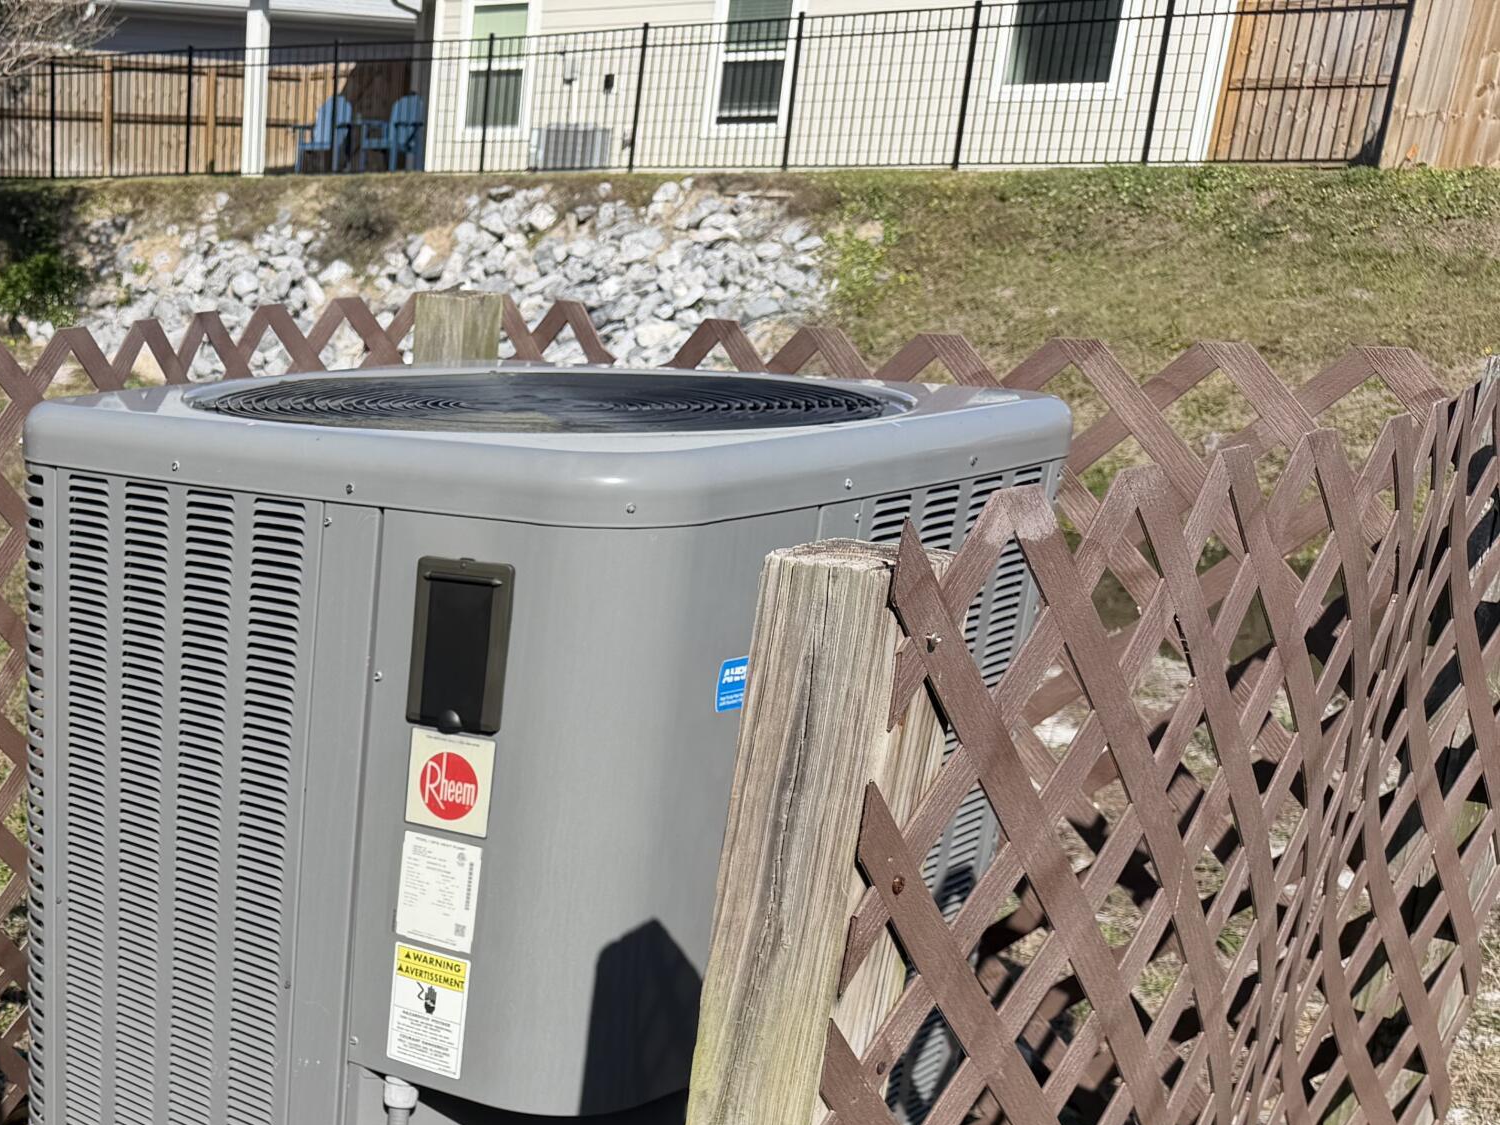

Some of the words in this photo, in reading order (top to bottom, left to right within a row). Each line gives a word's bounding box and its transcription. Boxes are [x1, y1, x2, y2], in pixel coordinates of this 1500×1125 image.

[425, 752, 476, 809] Rheem
[412, 952, 461, 973] WARNING
[404, 967, 465, 989] AVERTISSEMENT
